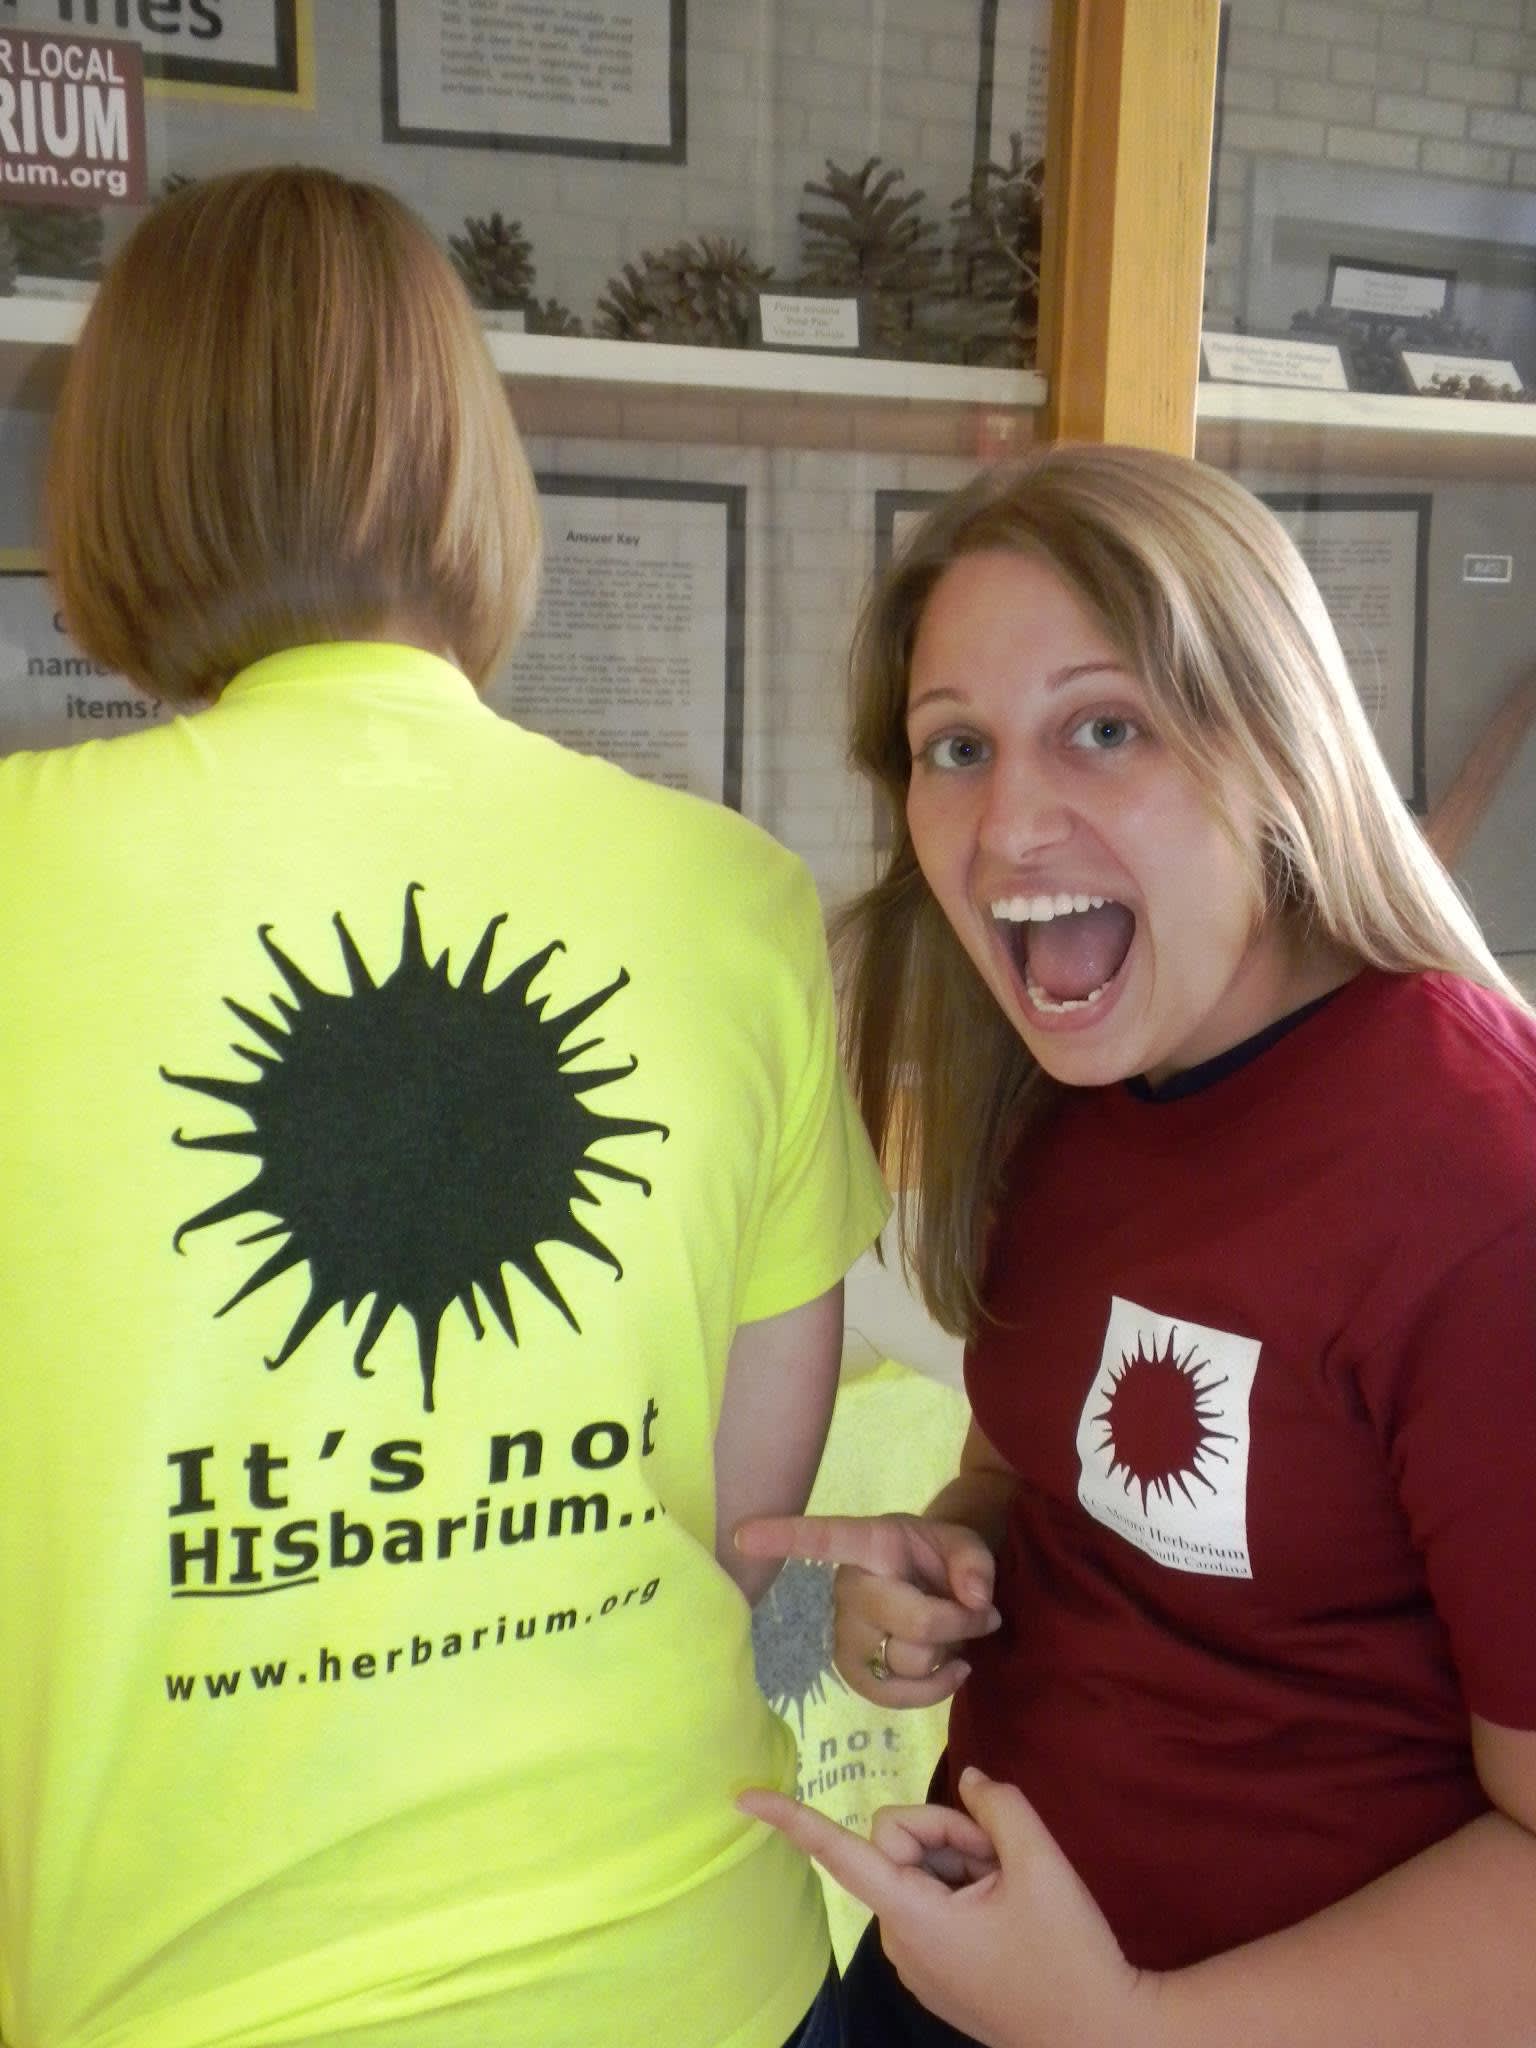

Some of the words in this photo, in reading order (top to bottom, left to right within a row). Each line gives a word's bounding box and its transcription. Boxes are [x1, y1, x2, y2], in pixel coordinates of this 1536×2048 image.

[22, 41, 125, 84] LOCAL
[0, 77, 129, 161] RIUM
[566, 530, 614, 545] Answer
[616, 532, 640, 547] Key
[66, 693, 162, 720] items?
[167, 1430, 425, 1518] It's
[489, 1397, 659, 1484] not
[1148, 1526, 1246, 1561] Herbarium
[165, 1577, 661, 1702] www.herbarium.org
[820, 1727, 901, 1763] not
